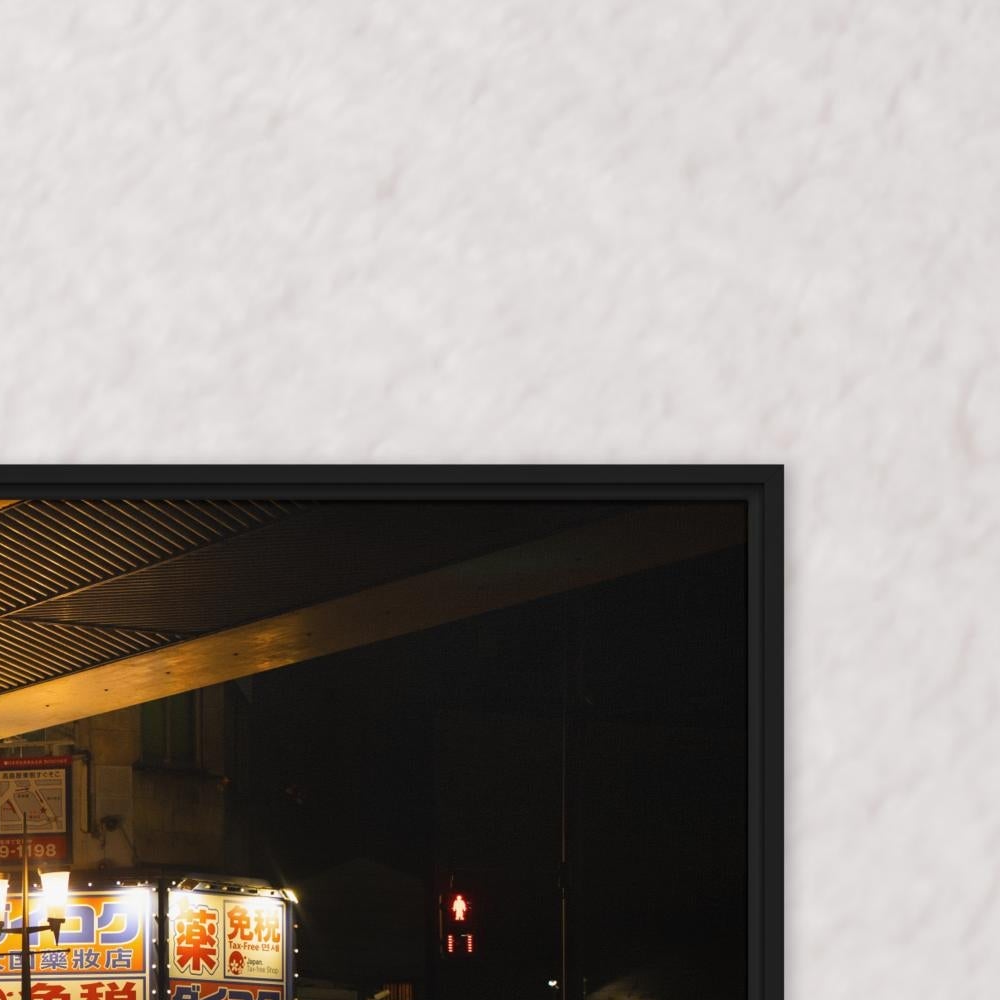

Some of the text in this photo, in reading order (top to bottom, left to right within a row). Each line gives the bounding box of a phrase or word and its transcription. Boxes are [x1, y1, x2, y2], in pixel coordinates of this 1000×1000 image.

[176, 909, 217, 972] 薬
[227, 906, 281, 943] 免税
[229, 941, 260, 951] Tax-Free
